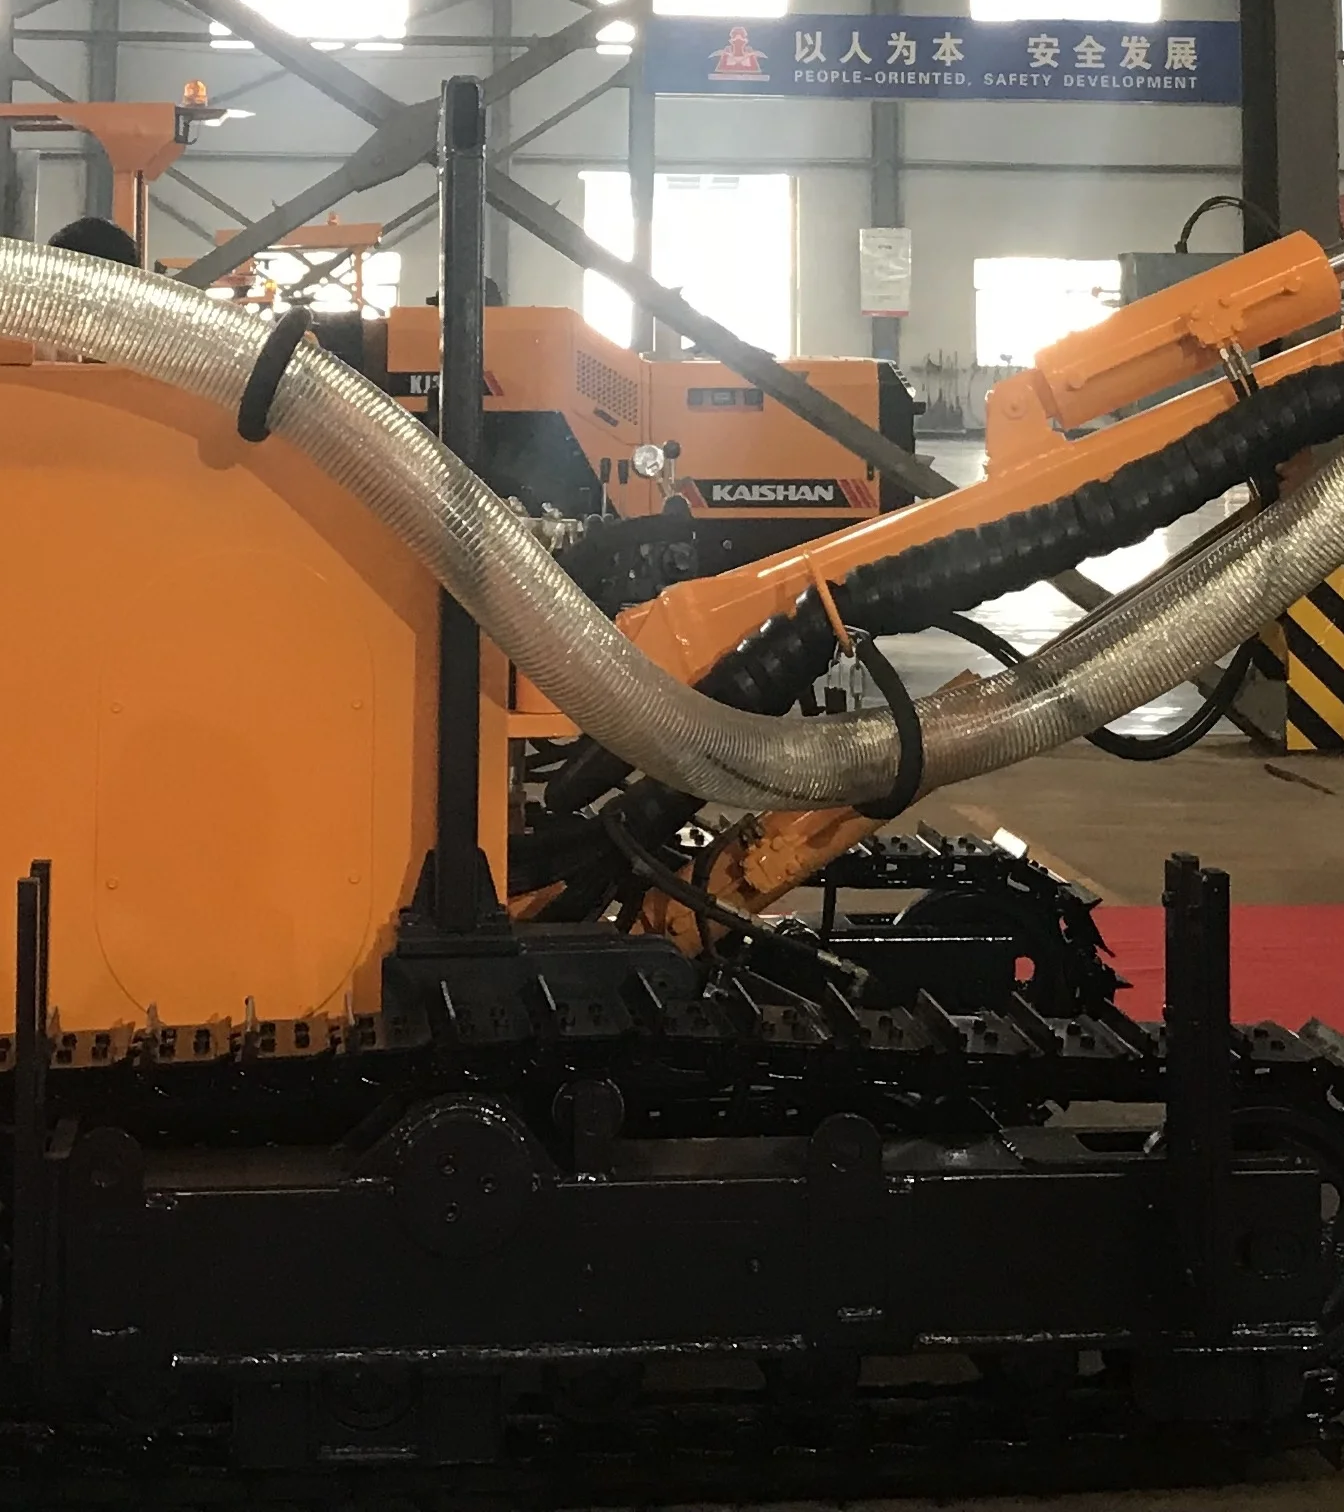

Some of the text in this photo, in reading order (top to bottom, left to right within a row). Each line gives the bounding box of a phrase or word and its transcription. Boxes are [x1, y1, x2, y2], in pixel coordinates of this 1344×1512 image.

[794, 30, 1198, 71] 以人为本 安全发展
[983, 72, 1053, 87] SAFETY
[1063, 74, 1199, 89] DEVELOPMENT
[712, 484, 834, 501] KAISHAN
